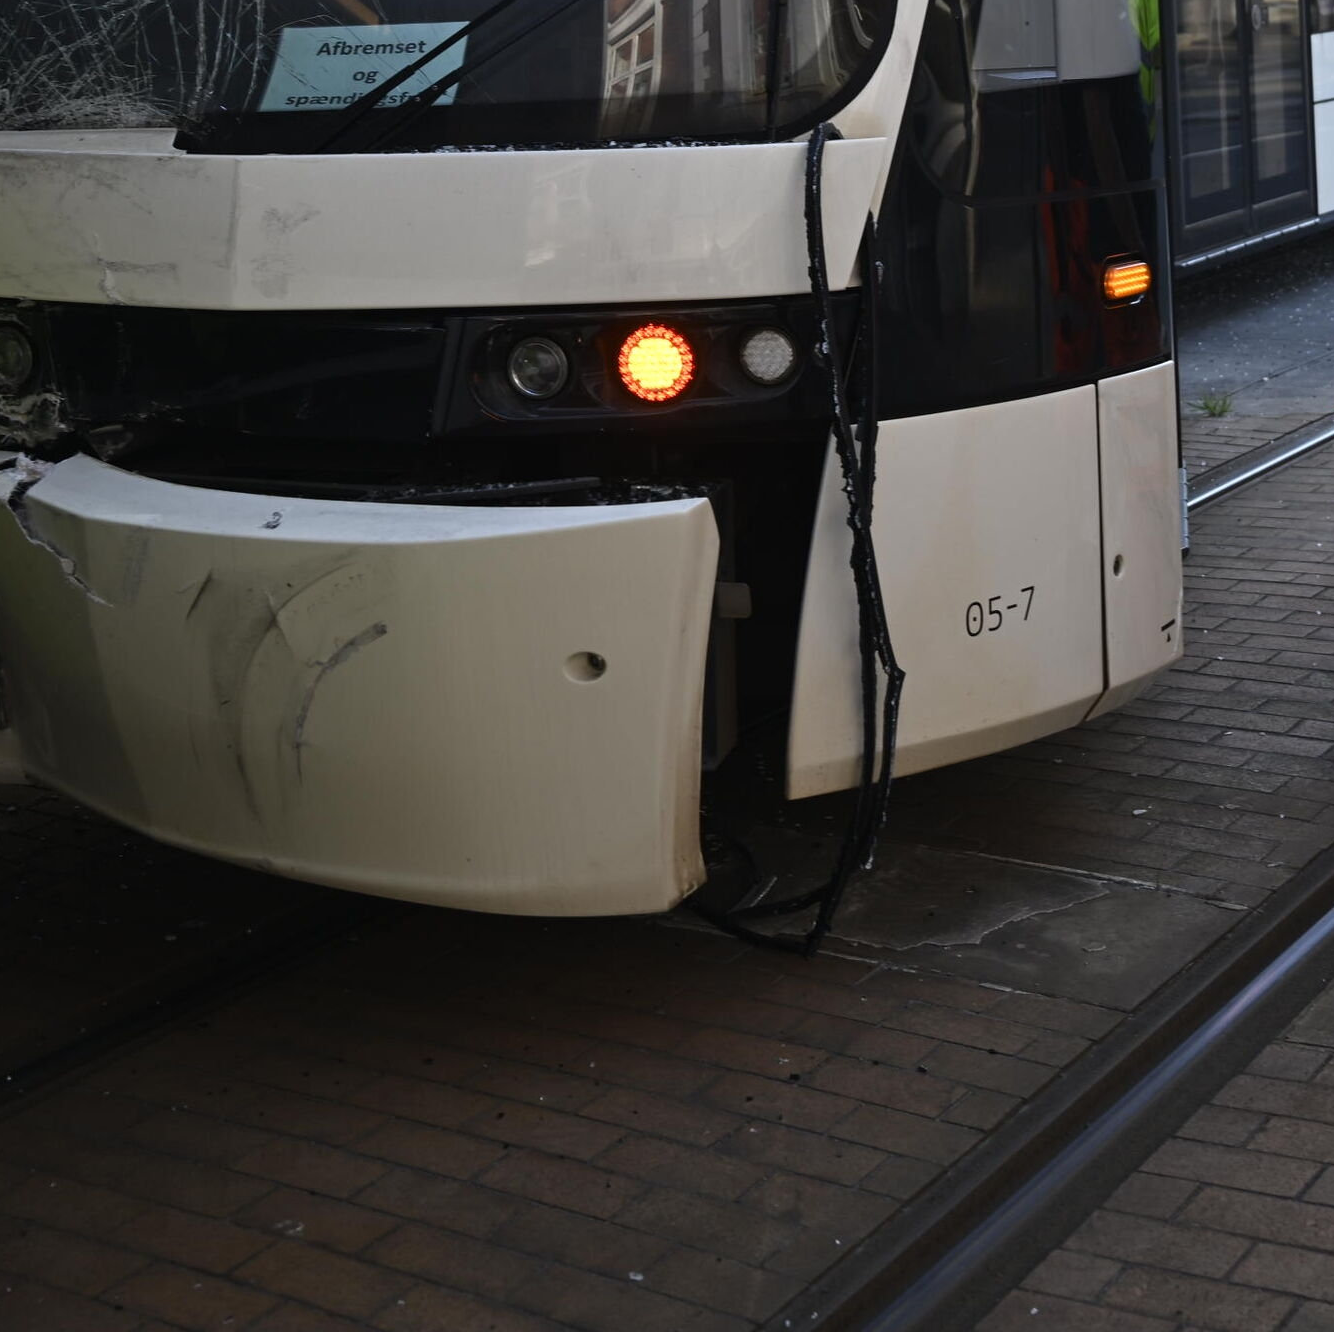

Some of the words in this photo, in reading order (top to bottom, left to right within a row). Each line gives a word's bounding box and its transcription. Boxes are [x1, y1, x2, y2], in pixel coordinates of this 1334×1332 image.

[316, 40, 427, 57] Afbremset
[352, 70, 379, 84] og
[965, 585, 1035, 637] 05-7
